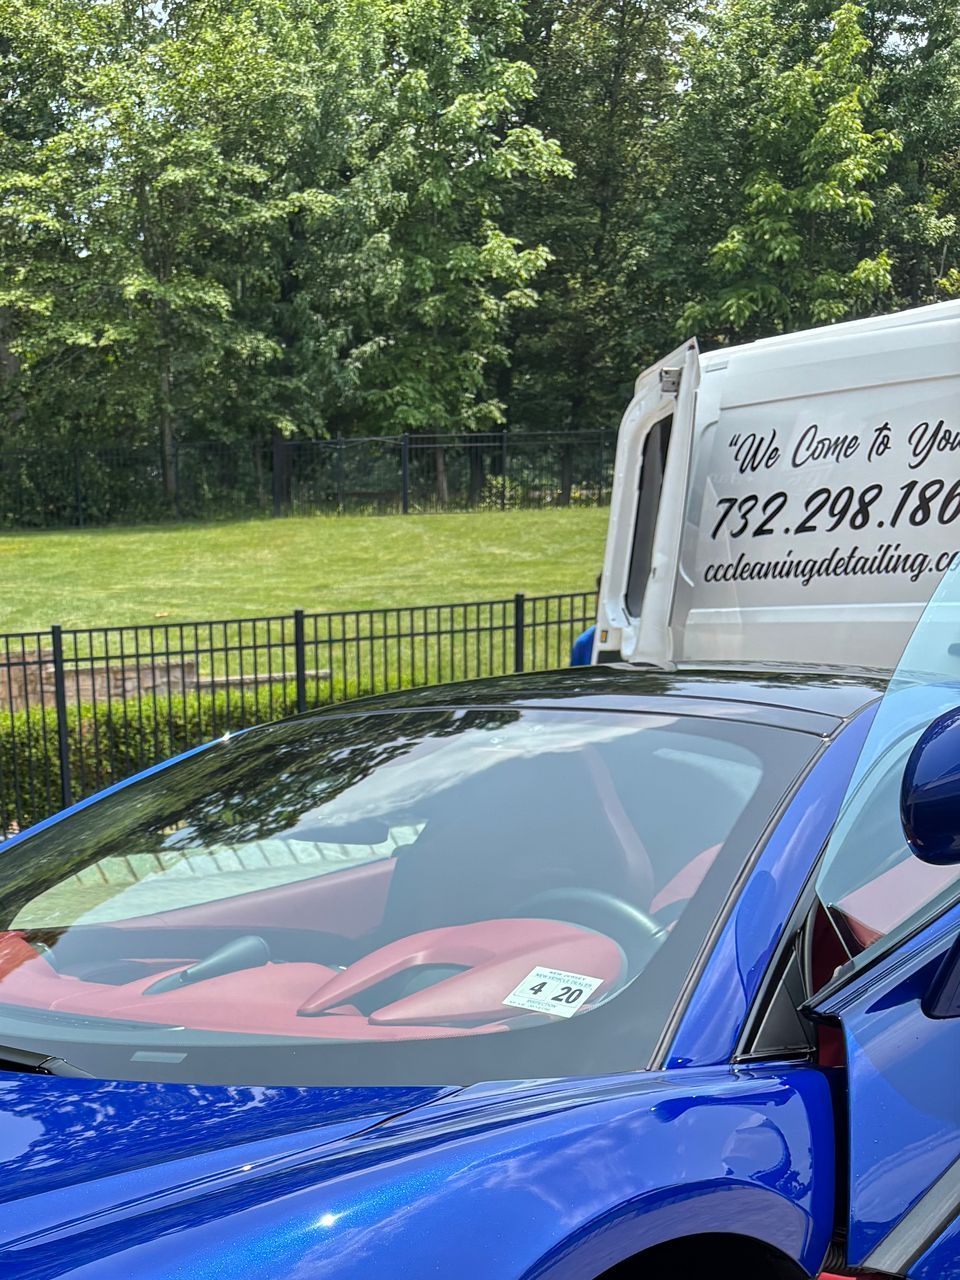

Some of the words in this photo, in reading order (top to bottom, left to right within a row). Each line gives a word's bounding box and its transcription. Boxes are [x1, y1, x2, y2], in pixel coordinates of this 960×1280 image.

[791, 424, 860, 468] Come
[868, 422, 892, 462] to
[711, 479, 960, 540] 732.298.186
[529, 981, 548, 995] 4
[551, 986, 583, 1004] 20
